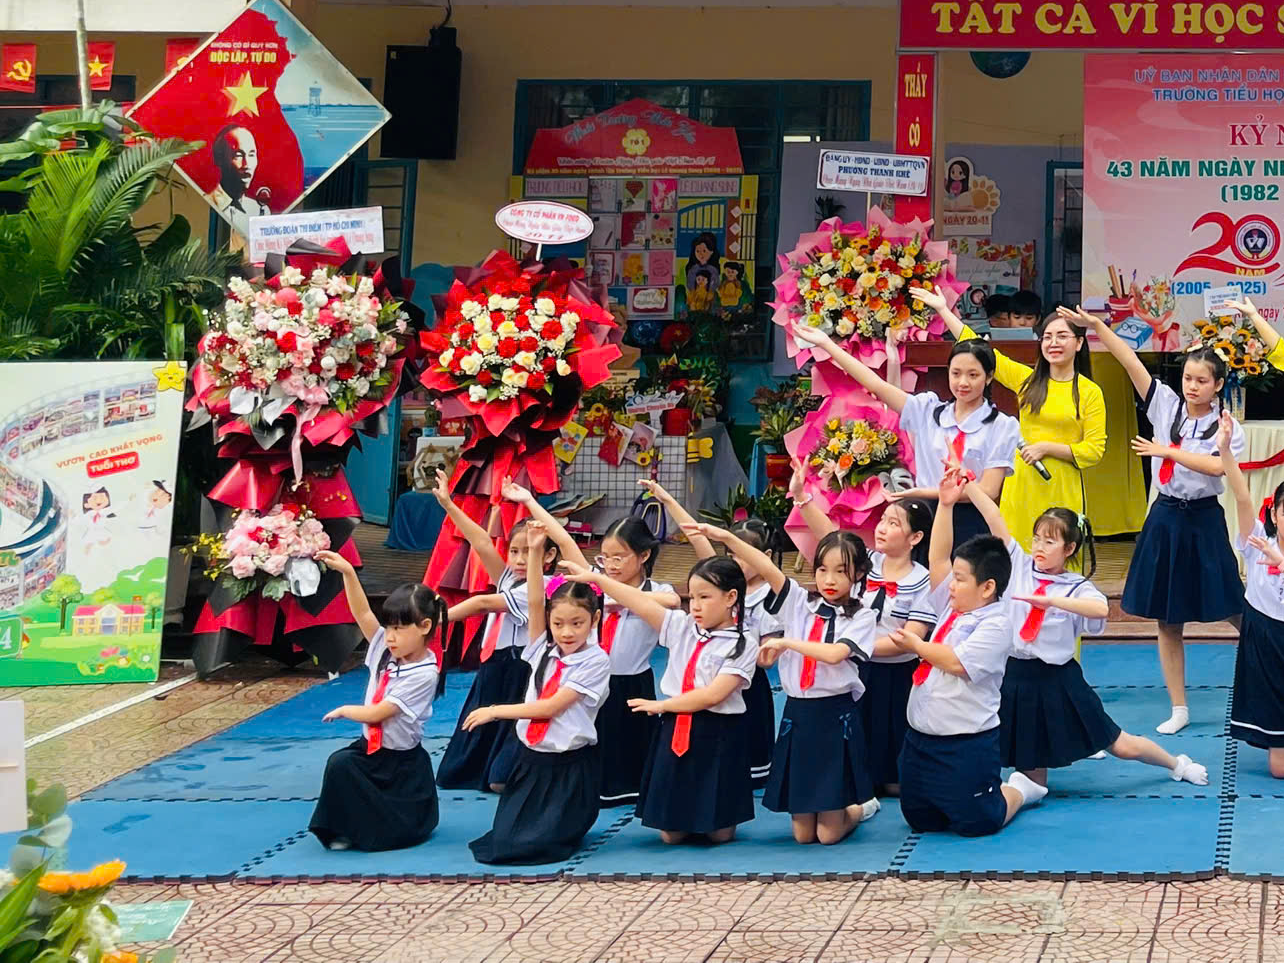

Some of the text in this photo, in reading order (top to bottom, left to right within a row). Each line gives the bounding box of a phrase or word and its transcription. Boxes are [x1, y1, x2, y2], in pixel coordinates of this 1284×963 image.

[1172, 2, 1265, 43] HỌC
[1160, 69, 1194, 83] BAN
[1198, 67, 1242, 83] NHÂN
[1247, 68, 1280, 83] DÂN
[1153, 86, 1219, 101] TRƯỜNG
[1223, 84, 1258, 101] TIỂU
[908, 117, 921, 148] CÔ
[1228, 114, 1268, 147] KỶ
[1106, 160, 1134, 178] 43
[1140, 155, 1191, 178] NĂM
[1198, 155, 1255, 178] NGÀY
[1220, 184, 1280, 203] (1982
[89, 448, 108, 459] CAO
[110, 441, 134, 454] KHÁT
[136, 434, 163, 446] VỌNG
